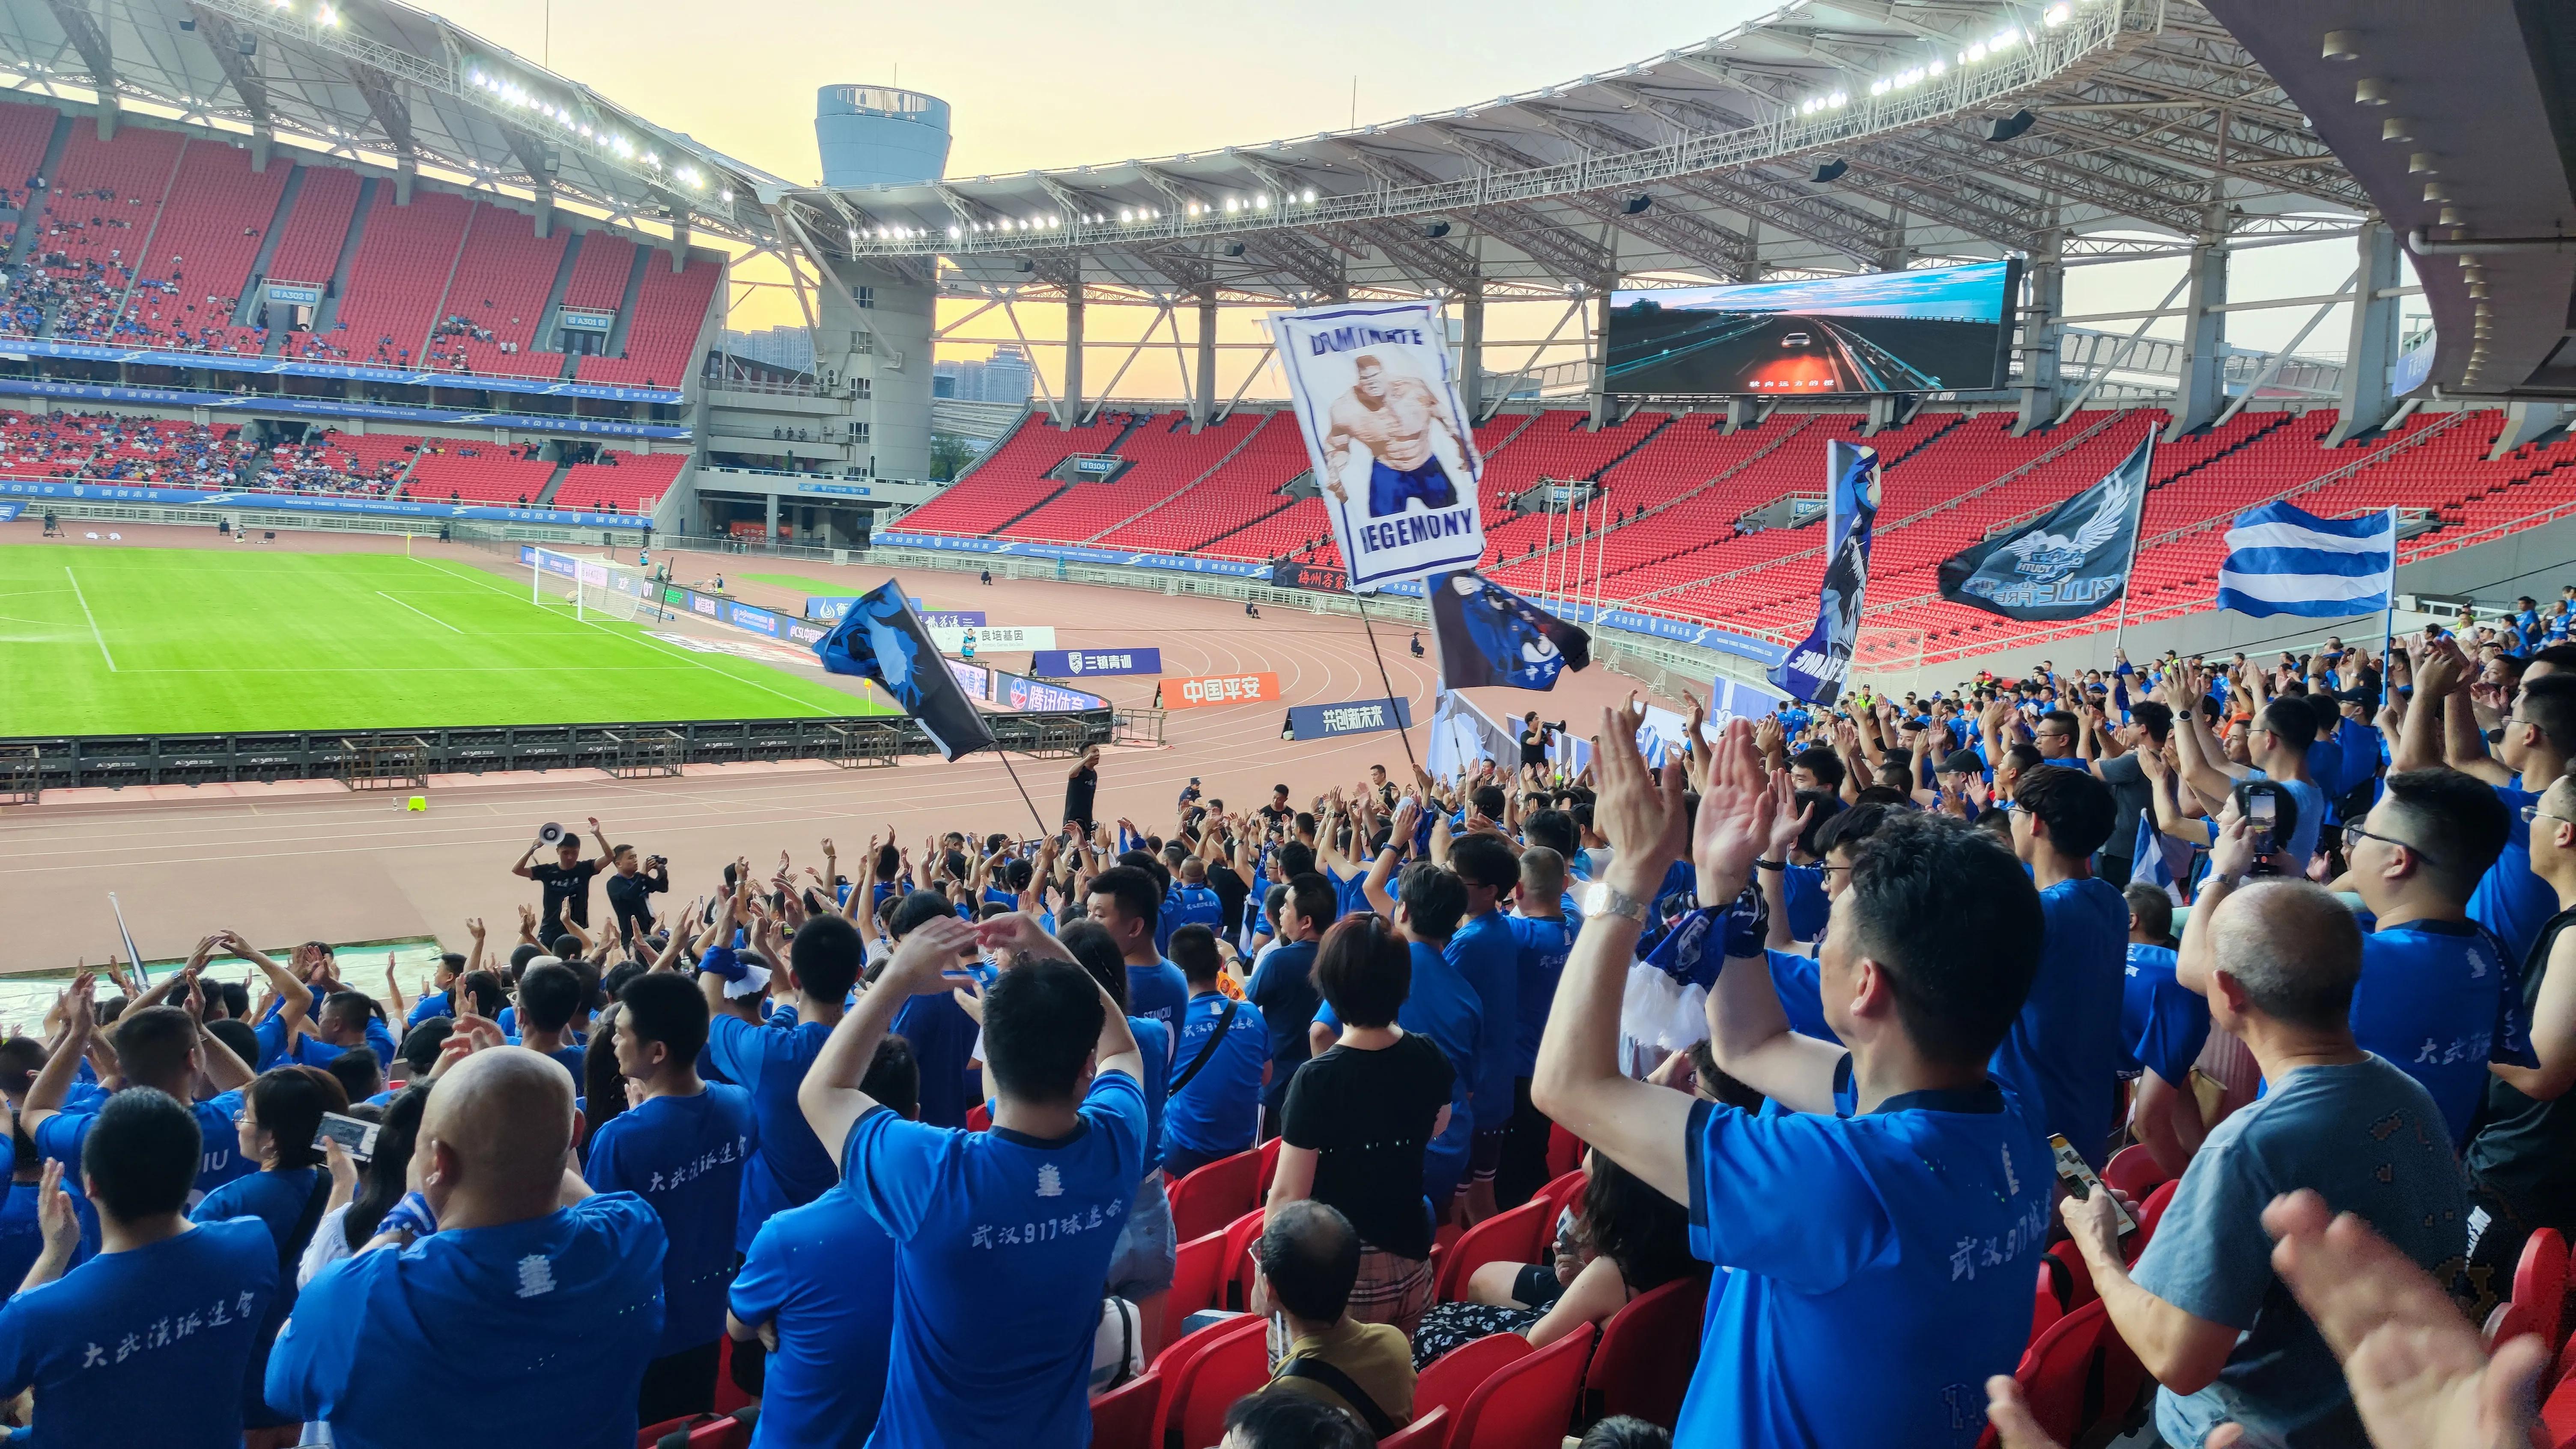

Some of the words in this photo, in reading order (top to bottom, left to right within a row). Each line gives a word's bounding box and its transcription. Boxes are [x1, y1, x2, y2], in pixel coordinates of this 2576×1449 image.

[281, 291, 304, 300] A302
[1297, 569, 1345, 590] 梅州客家
[982, 630, 1023, 641] 良培基因
[1085, 655, 1132, 670] 三镇青训
[1183, 677, 1260, 703] 中国平安
[1323, 705, 1384, 732] 共创新未来
